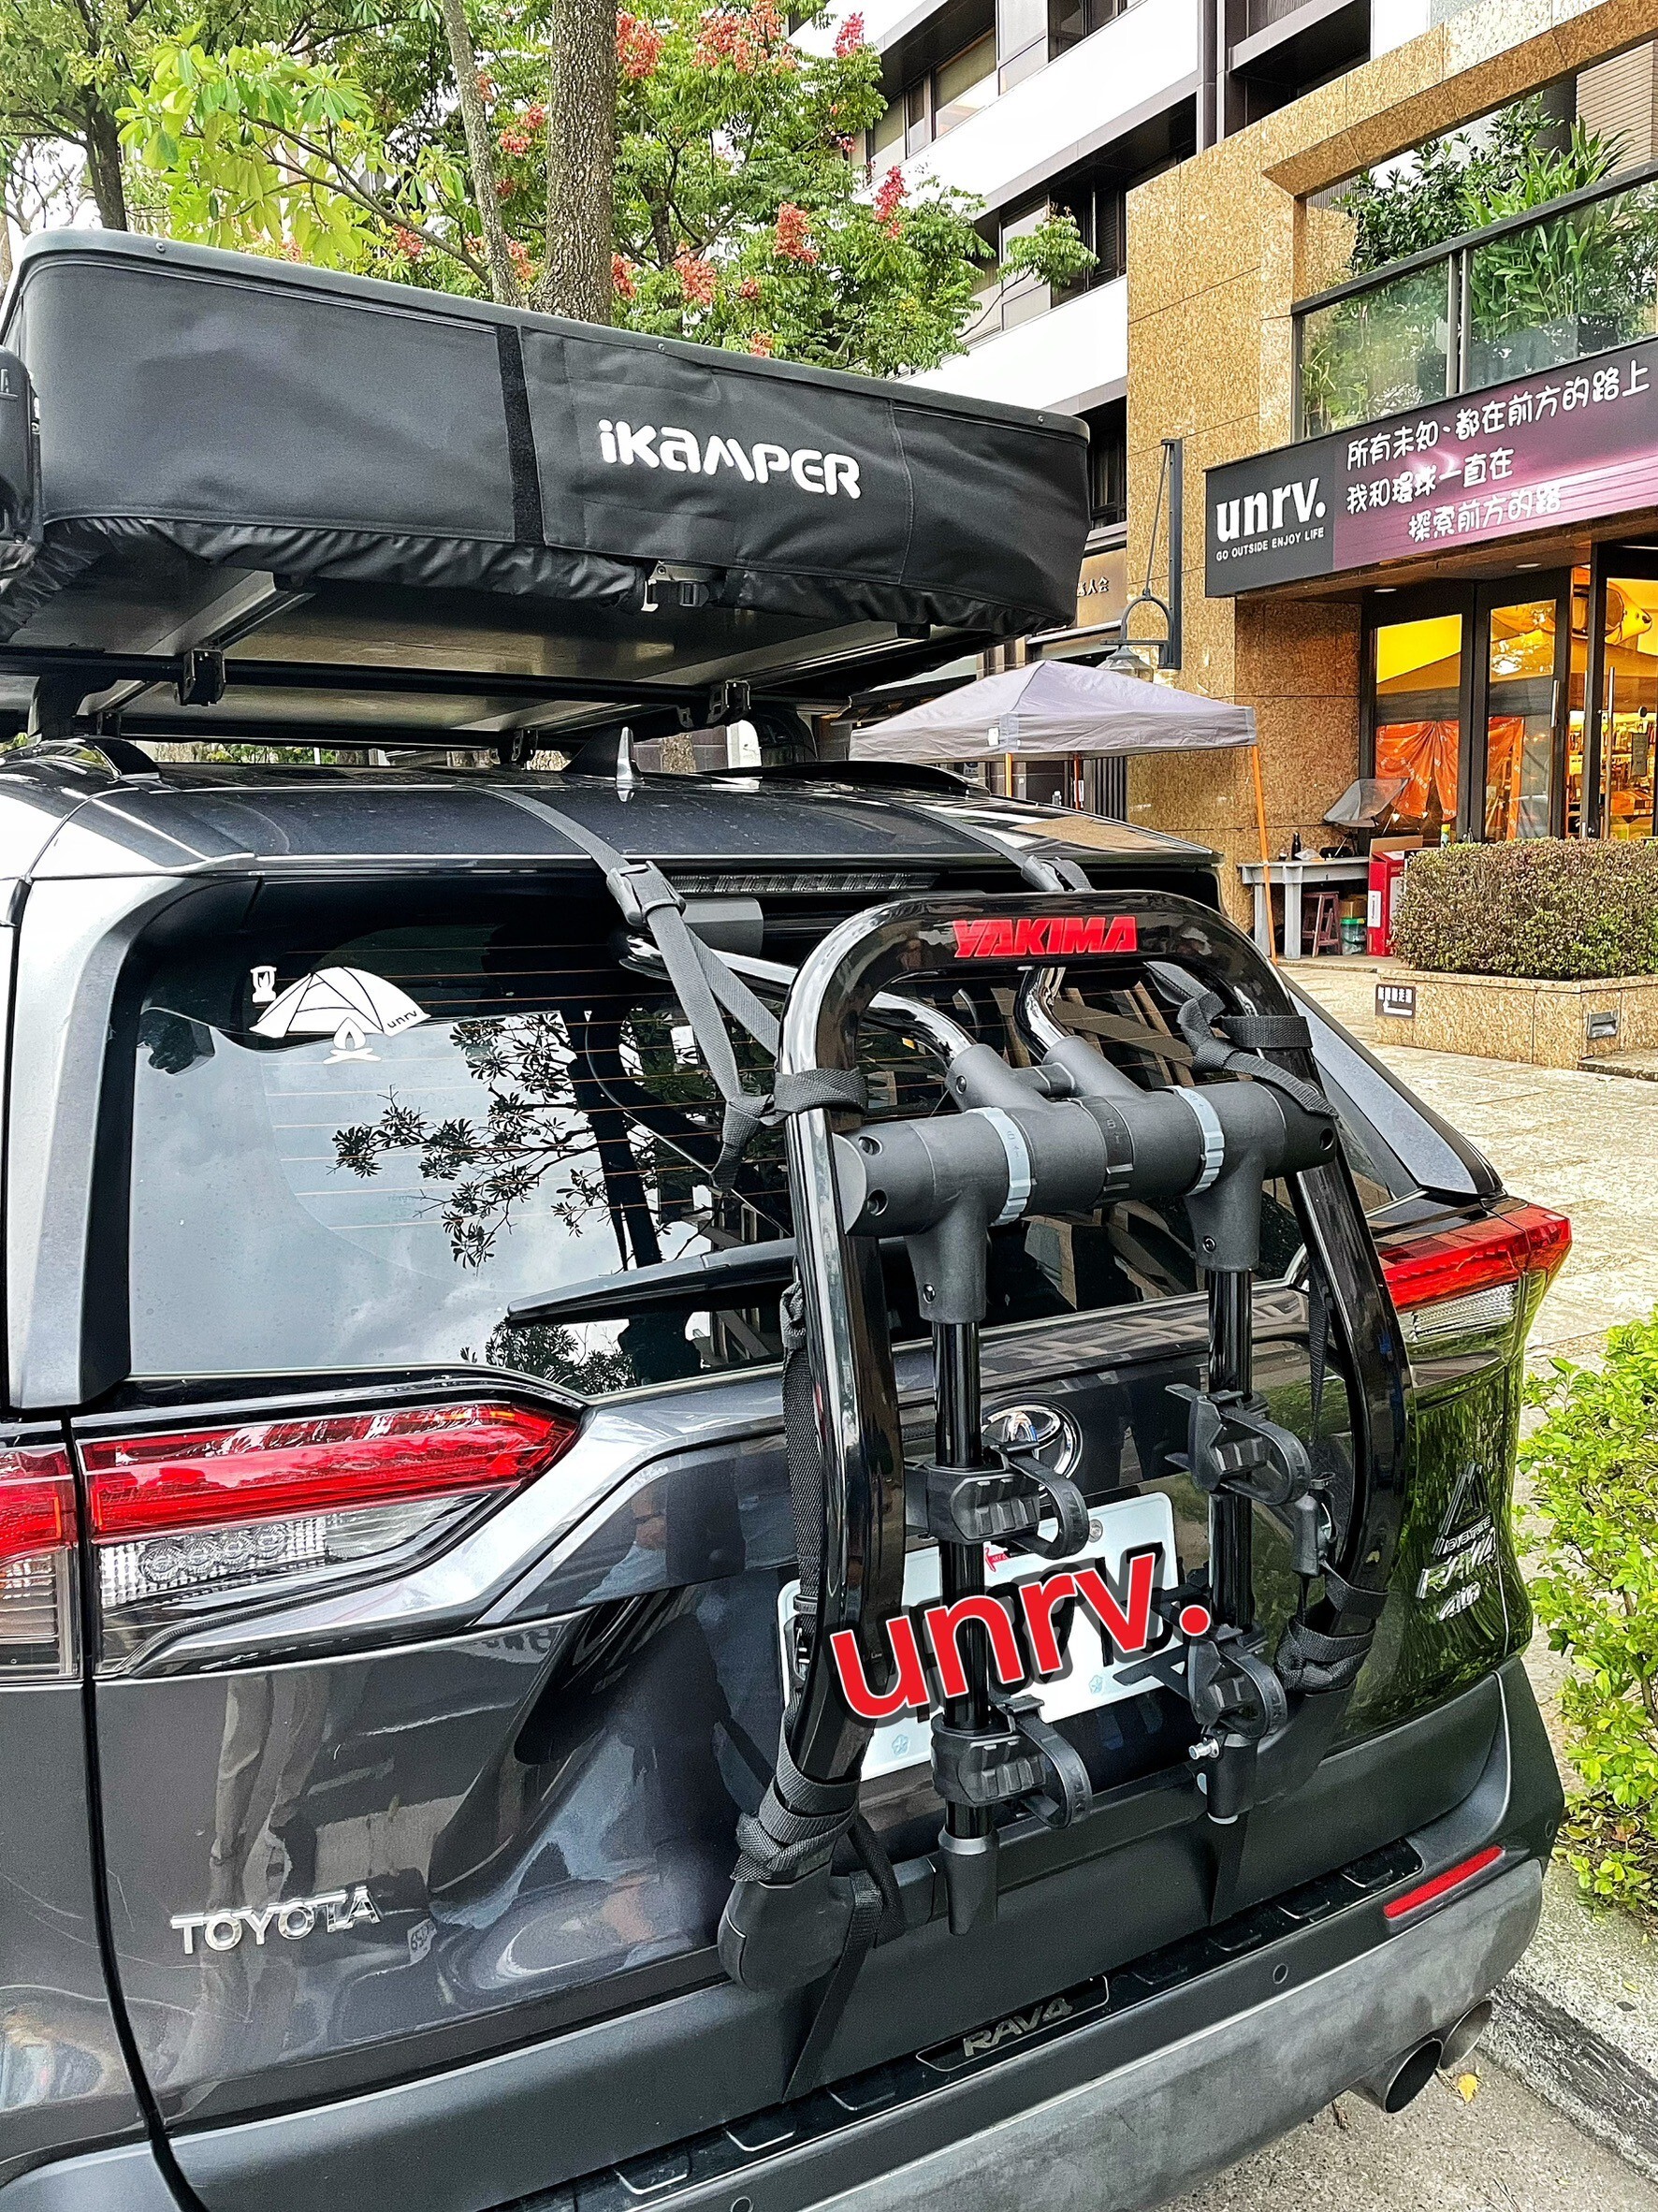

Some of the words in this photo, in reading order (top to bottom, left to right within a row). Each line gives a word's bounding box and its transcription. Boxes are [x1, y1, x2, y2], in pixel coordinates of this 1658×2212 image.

[1215, 476, 1327, 543] unrv.
[1408, 483, 1562, 544] 探索前方的路
[1215, 550, 1229, 561] GO
[1231, 540, 1269, 558] OUTSIDE
[1272, 531, 1302, 548] ENJOY
[1304, 526, 1325, 542] LIFE
[953, 916, 1138, 958] YAKIMA
[386, 1009, 418, 1029] unrv
[169, 1885, 382, 1955] TOYOTA
[962, 1996, 1074, 2058] RAV4
